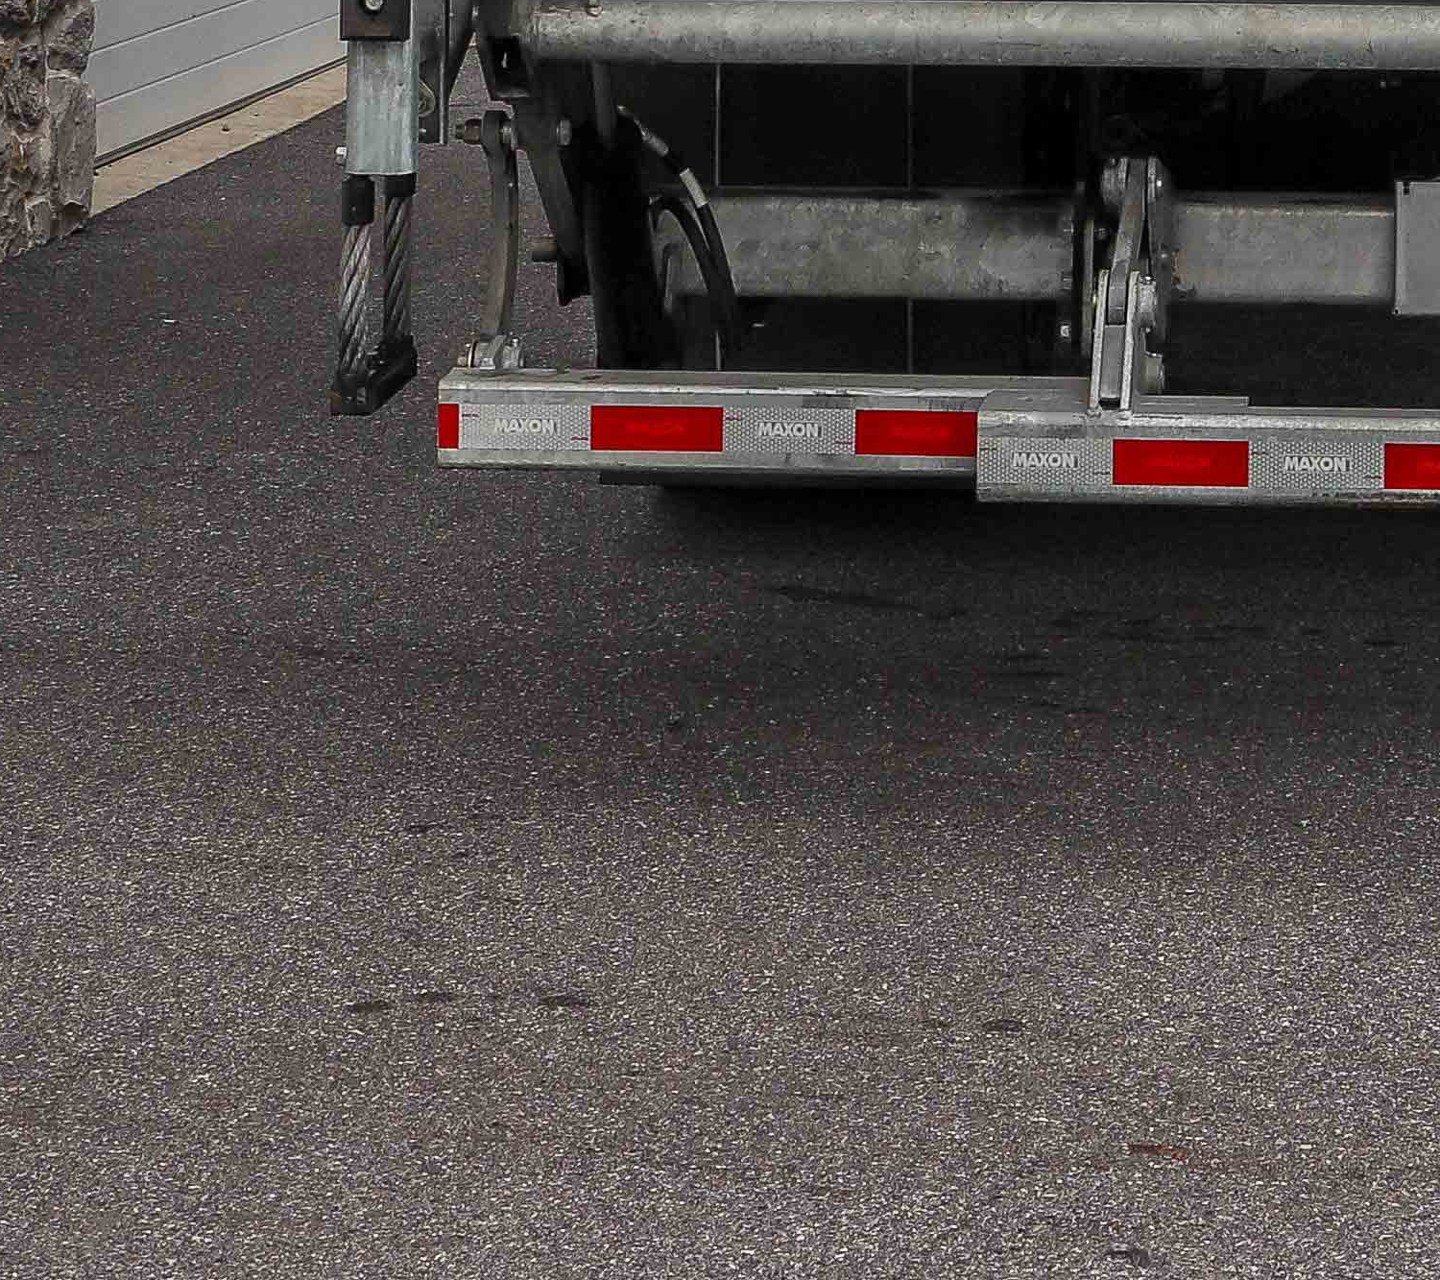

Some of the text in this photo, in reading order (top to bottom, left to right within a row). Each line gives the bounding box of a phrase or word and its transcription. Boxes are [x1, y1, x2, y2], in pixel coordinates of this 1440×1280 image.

[495, 418, 555, 434] MAXON
[759, 422, 819, 437] MAXON
[1012, 452, 1075, 467] MAXON
[1284, 456, 1347, 472] MAXON
